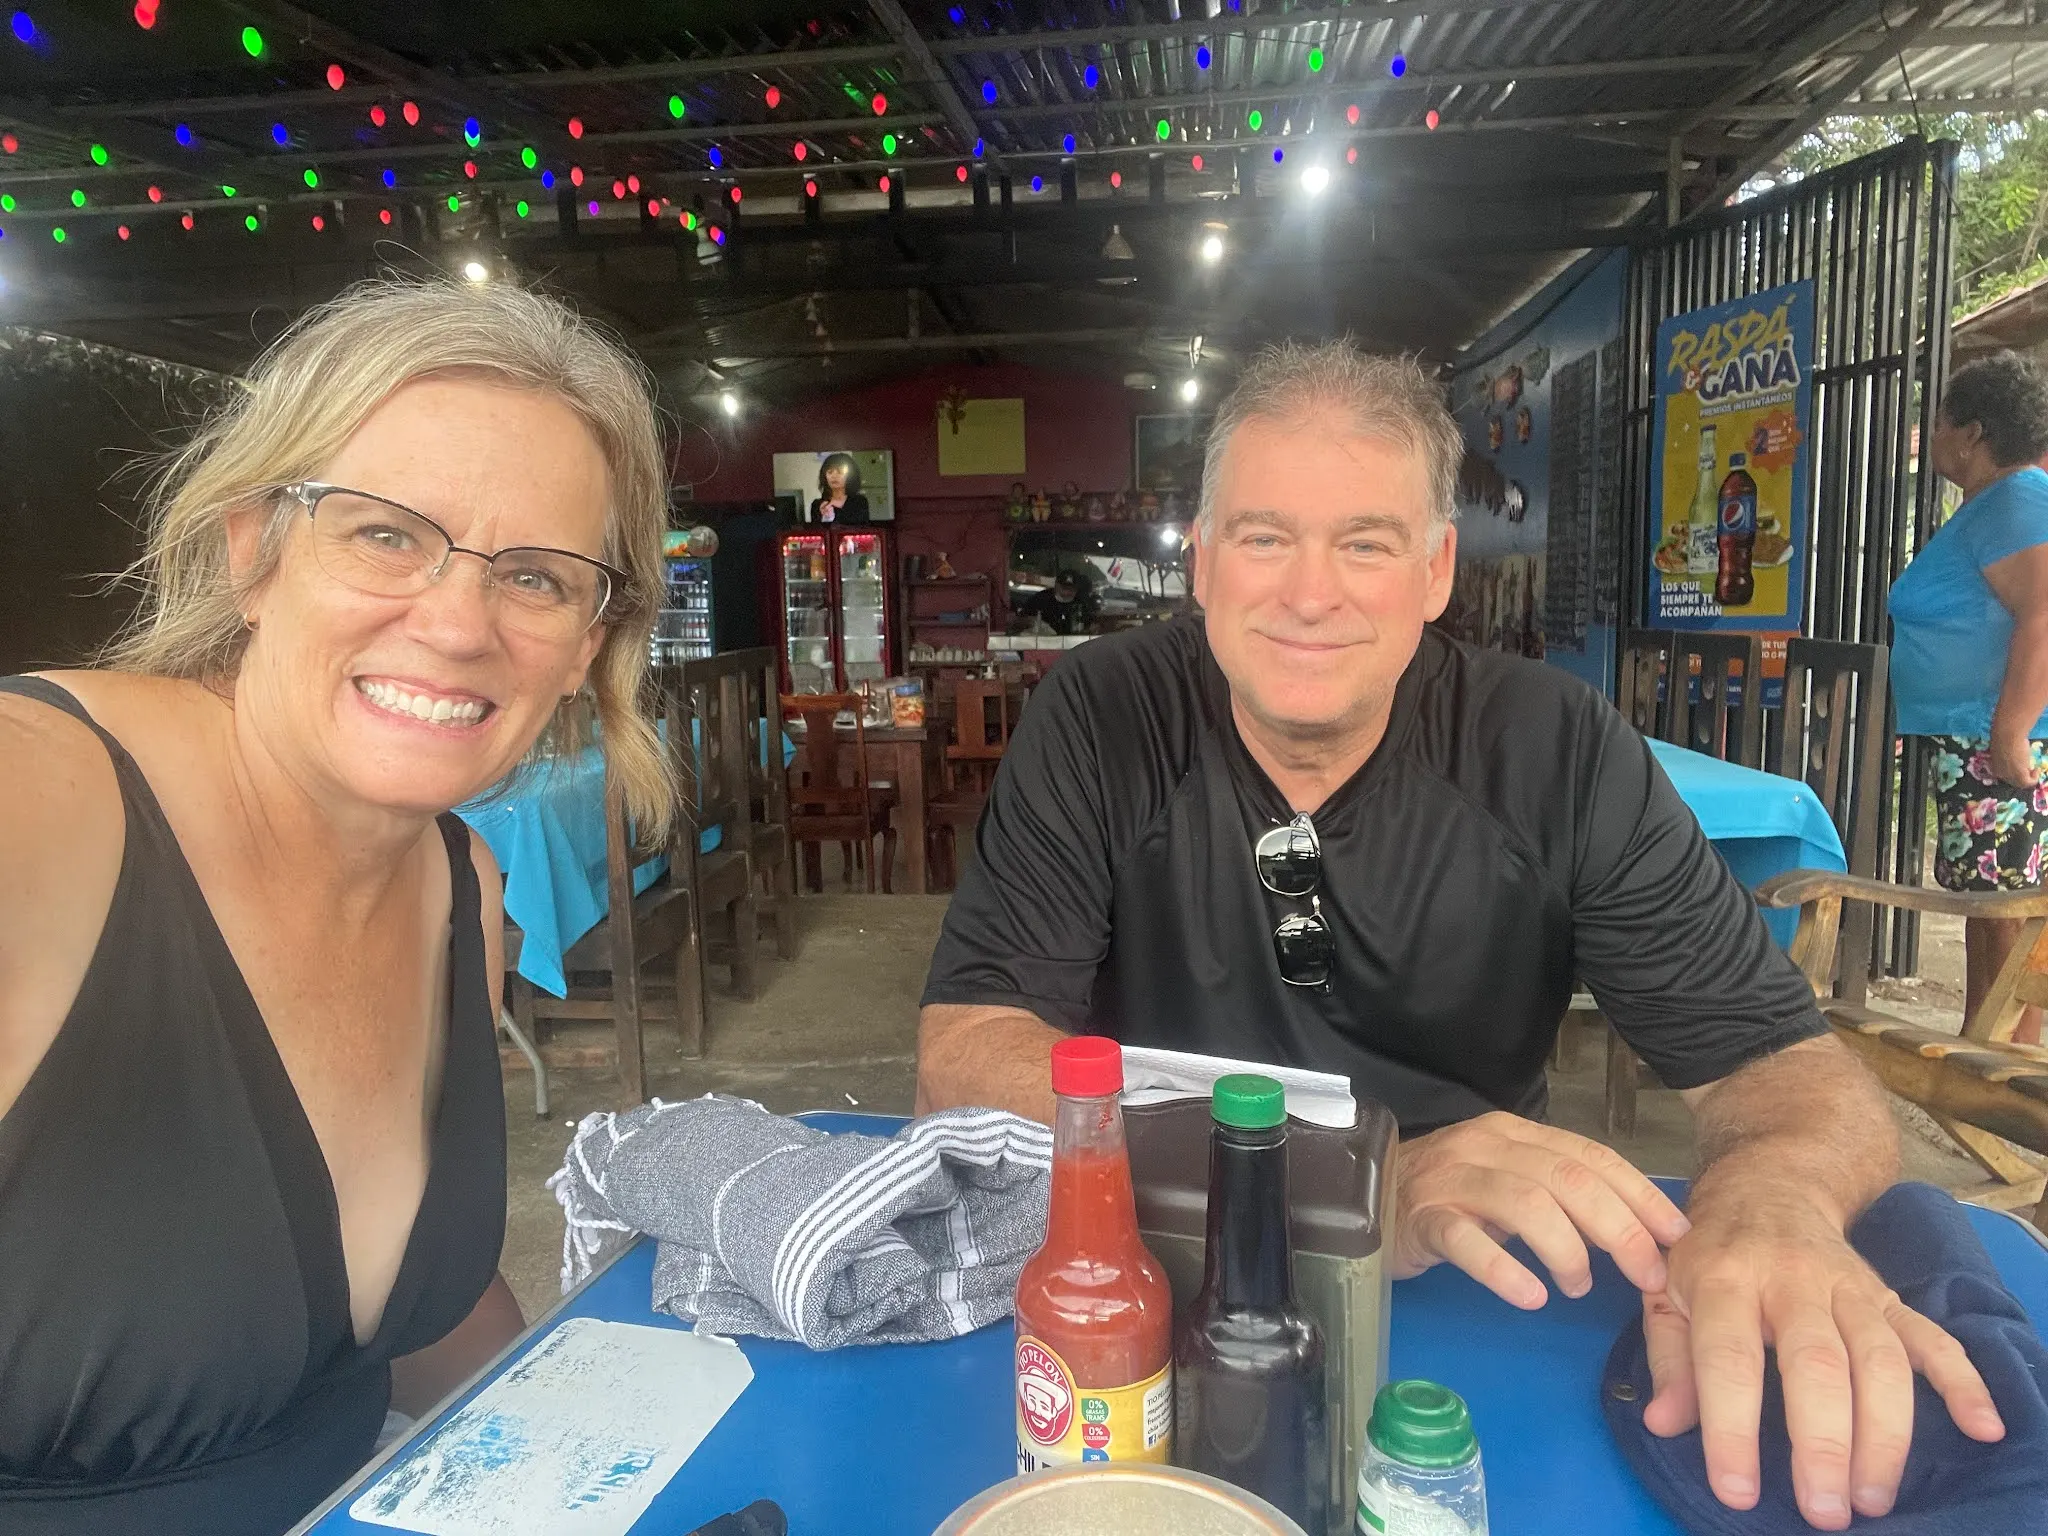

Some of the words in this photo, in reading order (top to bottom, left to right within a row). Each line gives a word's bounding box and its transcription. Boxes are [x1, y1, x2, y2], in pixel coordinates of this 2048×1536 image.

[1697, 336, 1800, 403] GANA
[1661, 582, 1679, 593] LOS
[1681, 580, 1701, 593] QUE
[1661, 592, 1700, 605] SIEMPRE
[1702, 592, 1713, 604] TE
[1660, 603, 1722, 618] ACOMPAÑAN
[1028, 1349, 1062, 1384] PELON
[1088, 1400, 1104, 1409] 0%
[1088, 1427, 1104, 1436] 0%
